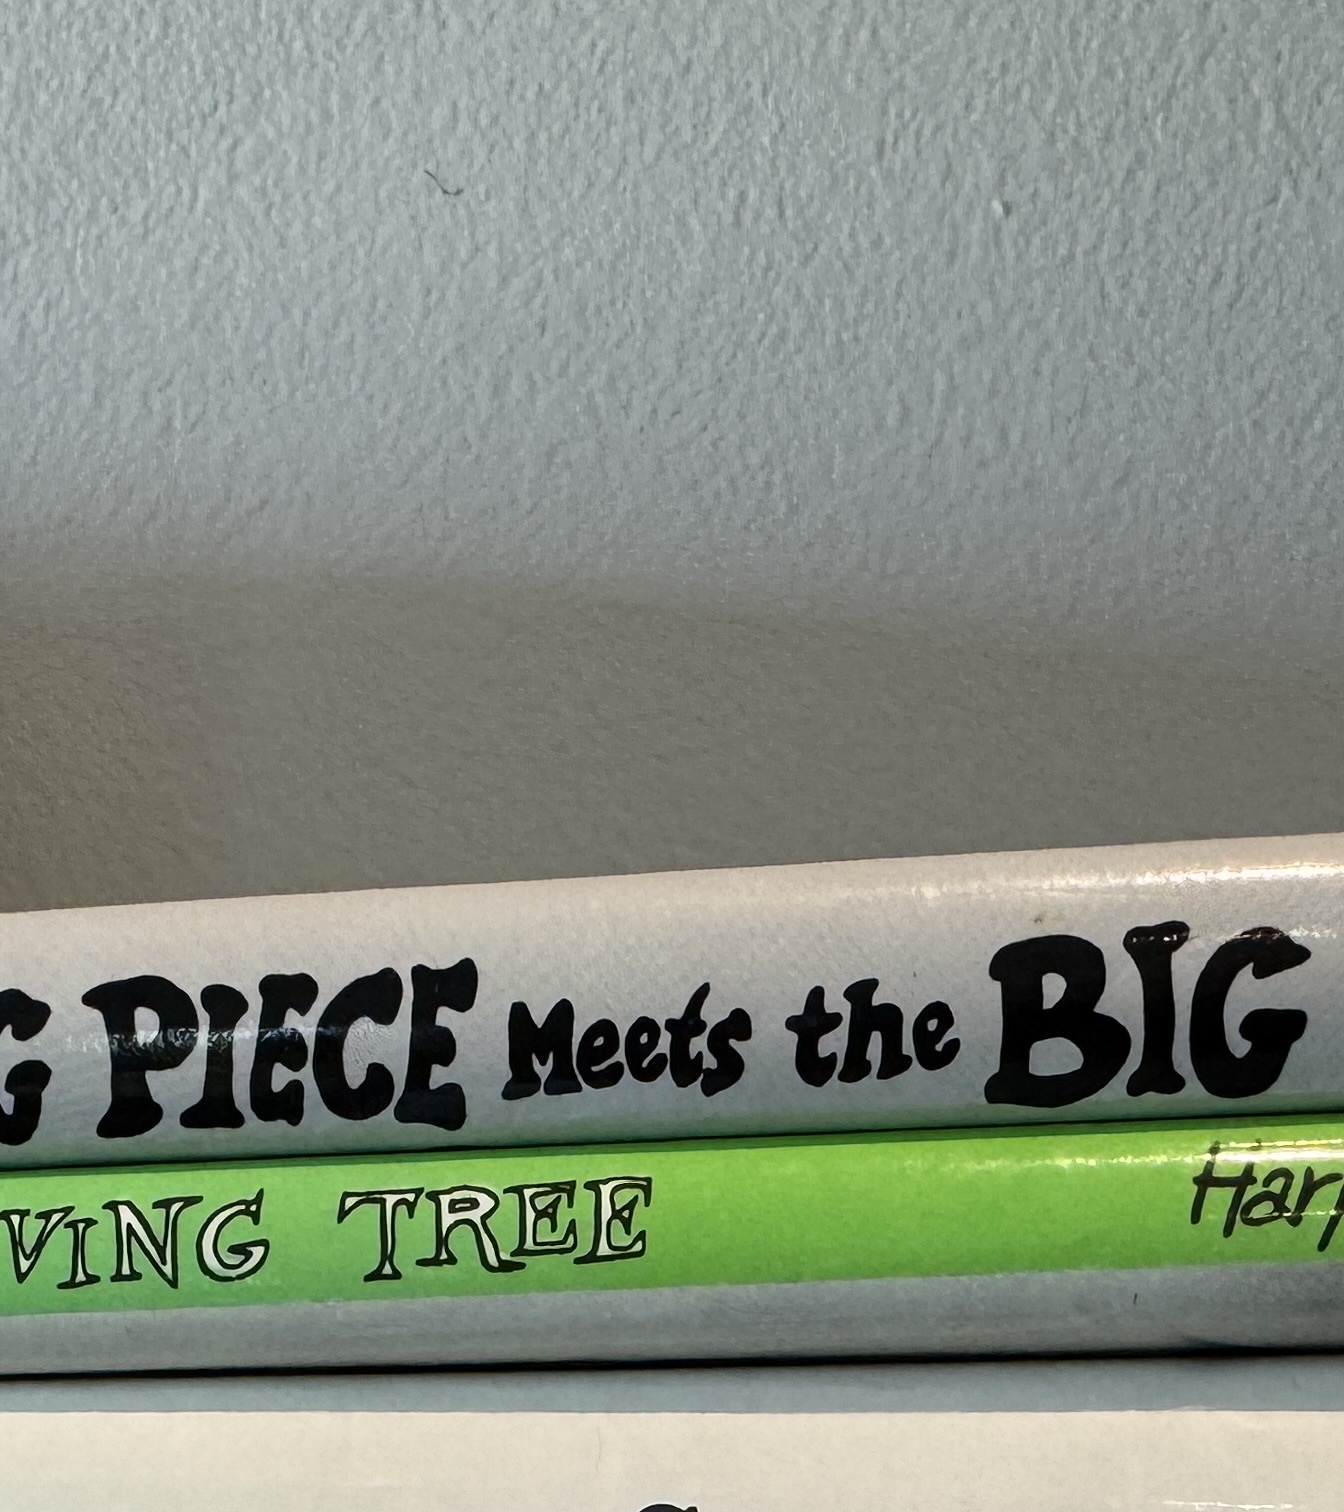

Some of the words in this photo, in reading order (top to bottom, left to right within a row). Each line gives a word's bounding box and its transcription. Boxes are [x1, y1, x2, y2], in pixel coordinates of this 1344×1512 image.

[82, 958, 478, 1139] PIECE
[501, 982, 752, 1101] Meets
[785, 978, 960, 1087] the
[984, 921, 1313, 1108] BIG
[337, 1176, 652, 1272] TREE
